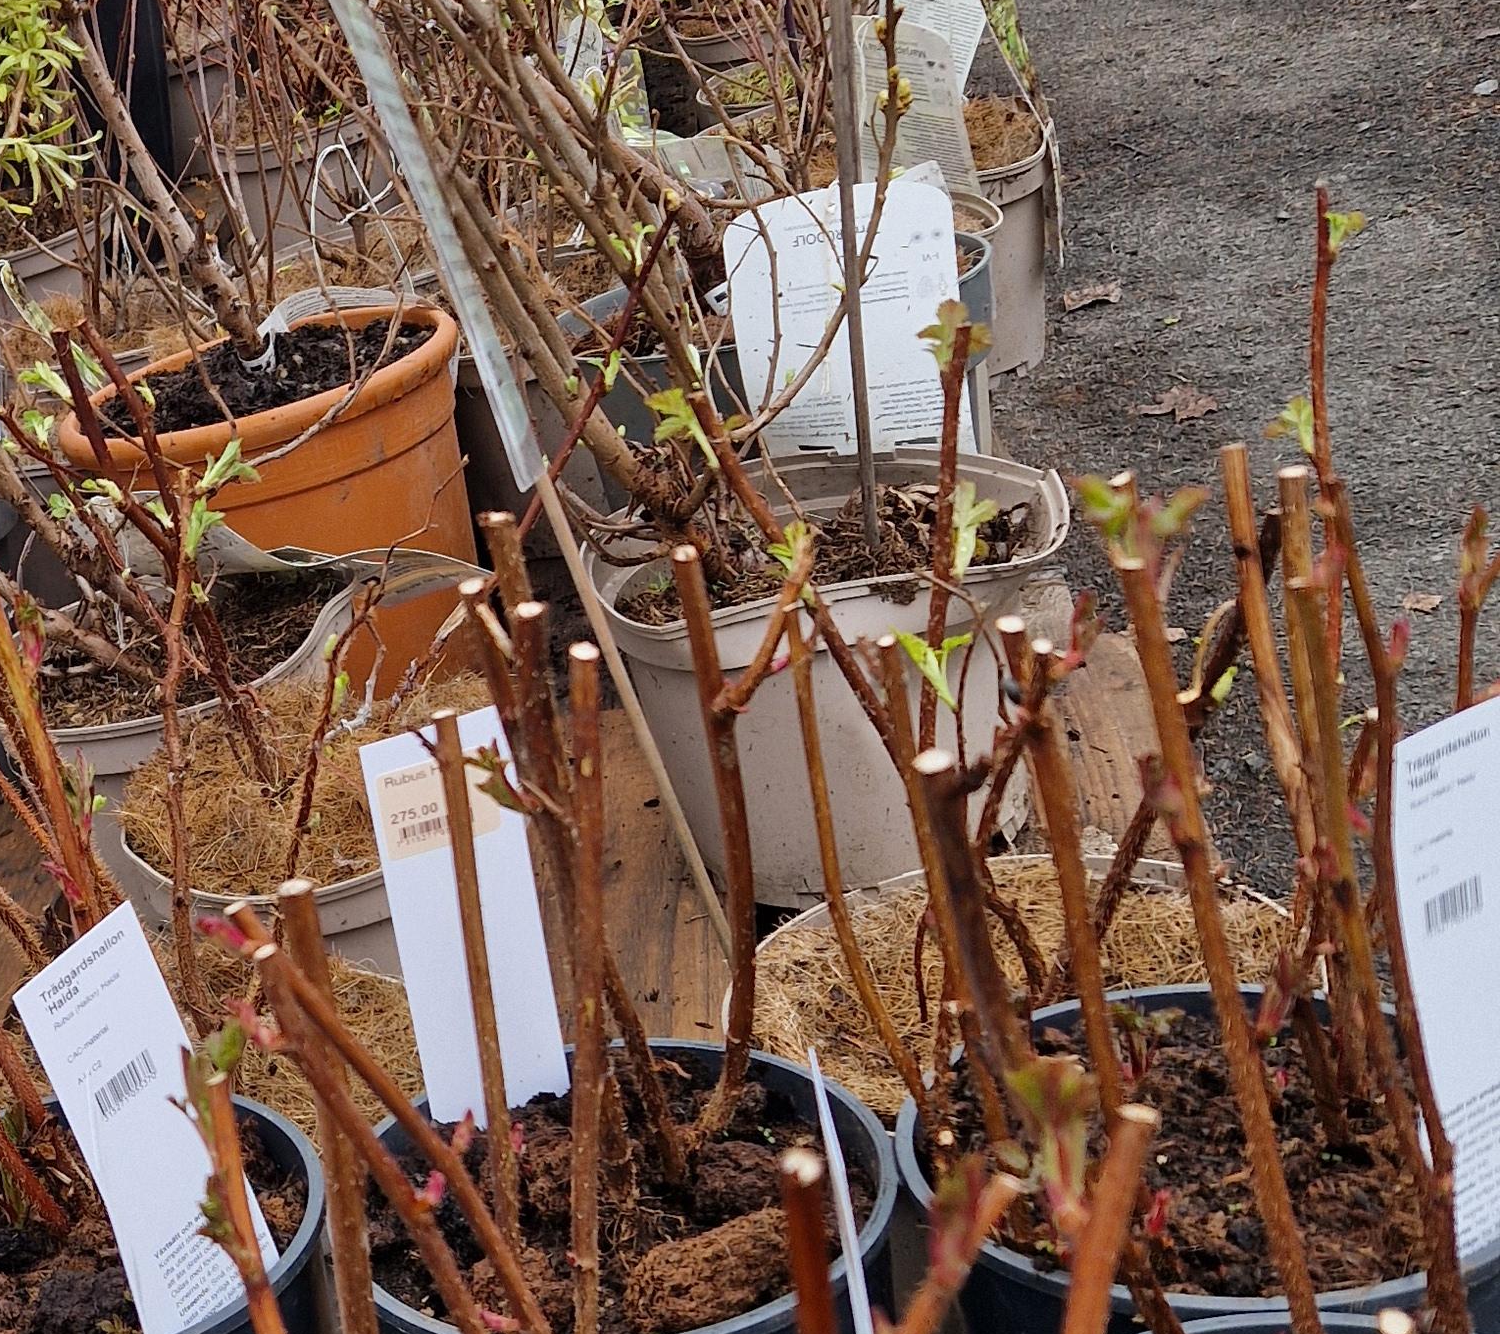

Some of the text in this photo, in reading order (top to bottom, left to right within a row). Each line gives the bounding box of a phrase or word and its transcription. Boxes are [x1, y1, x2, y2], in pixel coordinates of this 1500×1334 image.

[384, 771, 427, 788] Rubus
[390, 802, 438, 824] 275.00
[39, 930, 125, 1003] Trädgårdshallon
